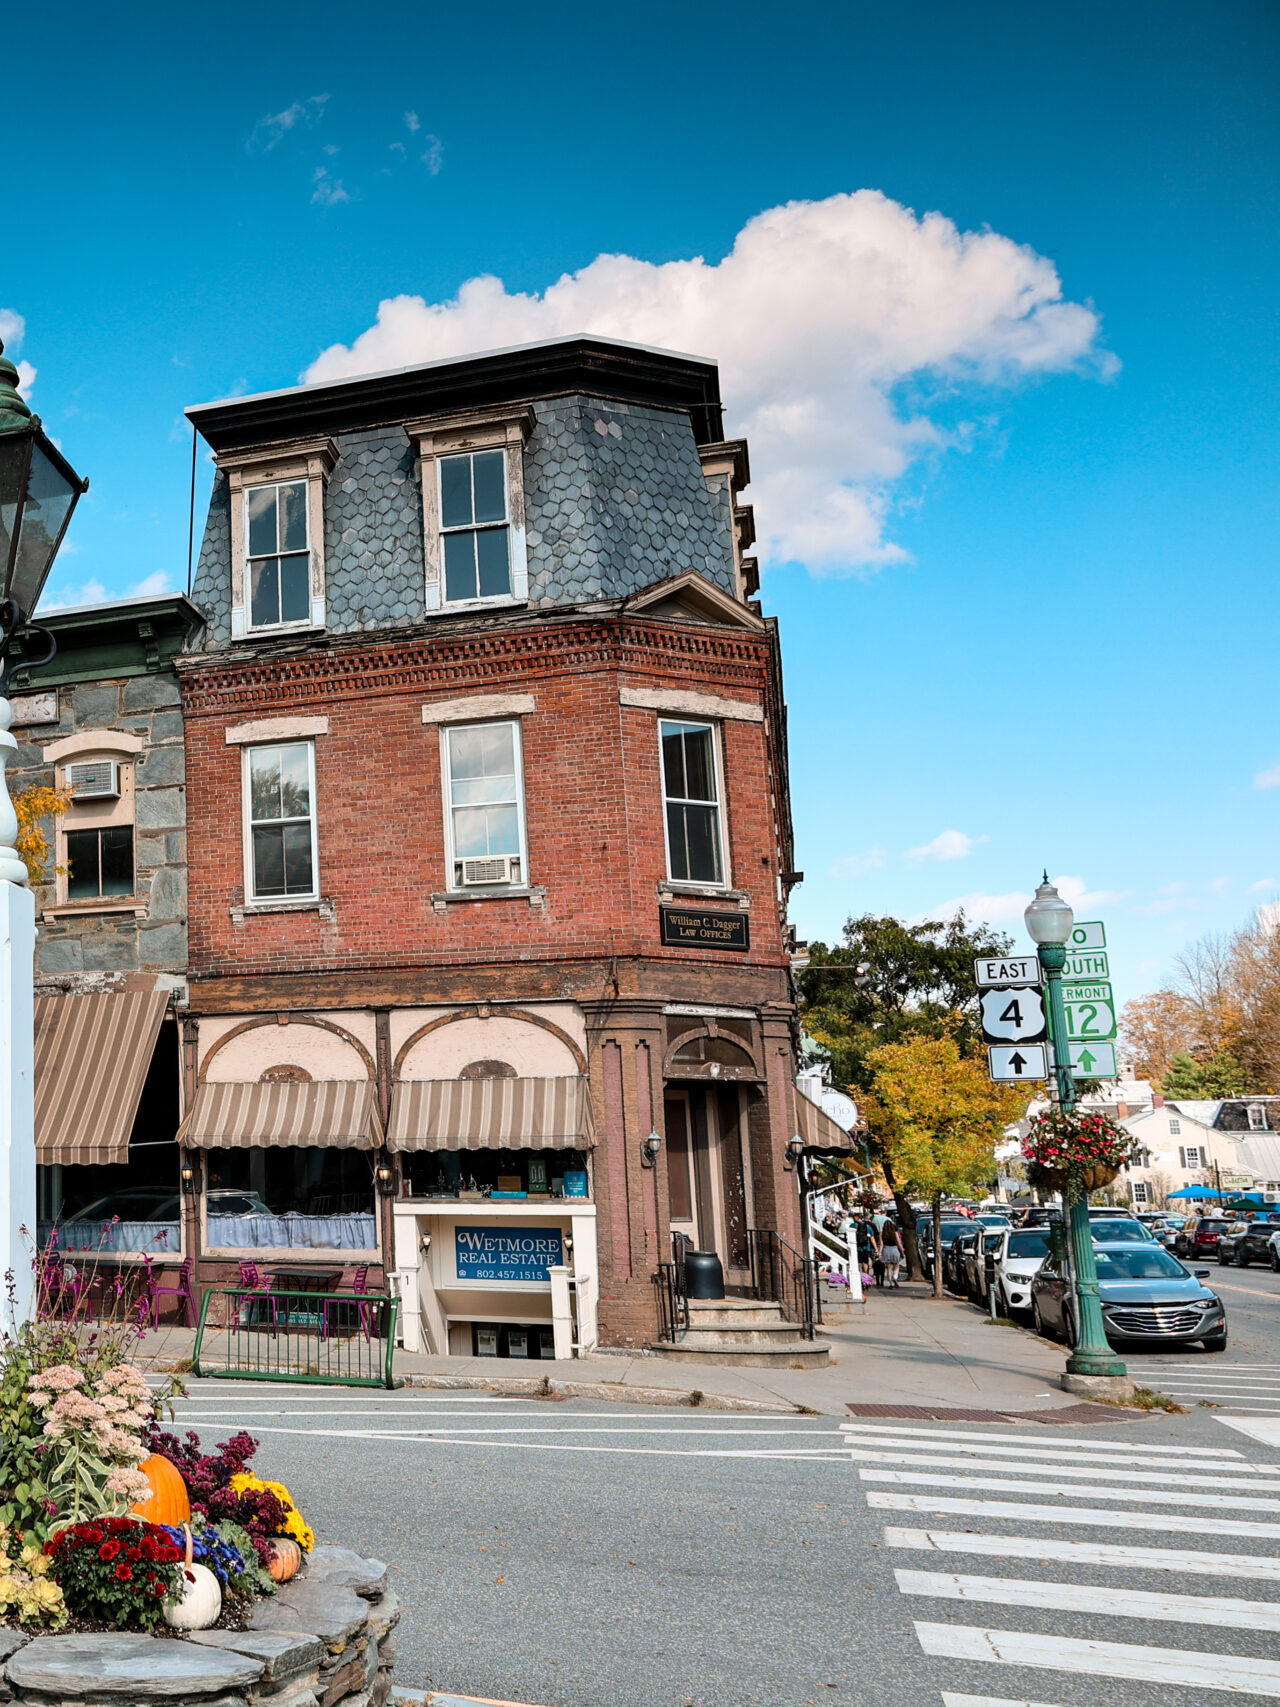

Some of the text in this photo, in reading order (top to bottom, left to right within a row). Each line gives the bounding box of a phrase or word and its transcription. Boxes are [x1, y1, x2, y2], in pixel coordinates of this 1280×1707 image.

[669, 915, 741, 931] William C. Dagger
[680, 927, 732, 940] LAW OFFICES
[1072, 929, 1087, 944] O
[987, 963, 1028, 979] EAST
[1061, 957, 1105, 976] OUTH
[1061, 987, 1107, 1000] ERMONT
[999, 999, 1024, 1028] 4
[1064, 1003, 1100, 1035] 12
[457, 1232, 560, 1253] WETMORE
[459, 1252, 557, 1266] REAL ESTATE
[476, 1269, 543, 1280] 802.457.1515
